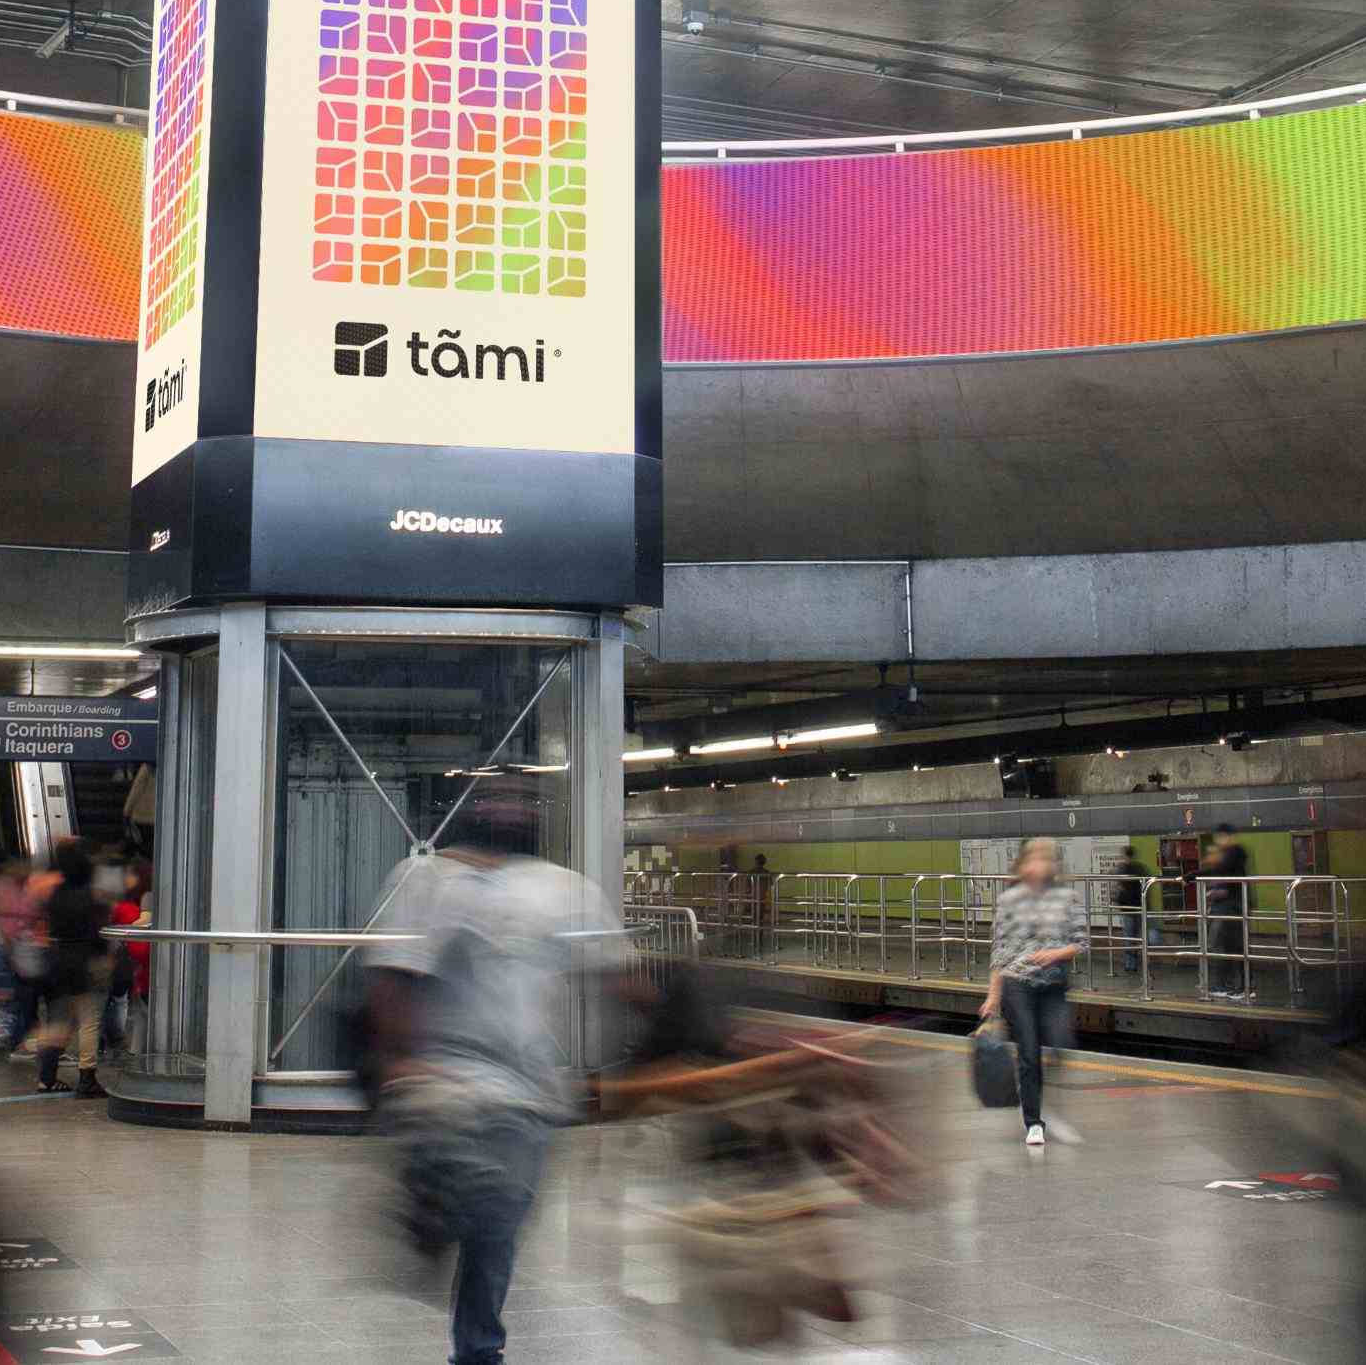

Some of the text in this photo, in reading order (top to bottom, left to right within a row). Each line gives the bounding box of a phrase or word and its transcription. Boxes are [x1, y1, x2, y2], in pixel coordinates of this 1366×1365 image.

[406, 328, 545, 383] tãmi
[157, 358, 185, 419] tãmi
[390, 510, 503, 534] JCDecaux
[7, 701, 72, 715] Embarque
[5, 722, 104, 738] Corinthians
[5, 739, 74, 756] Itaquera
